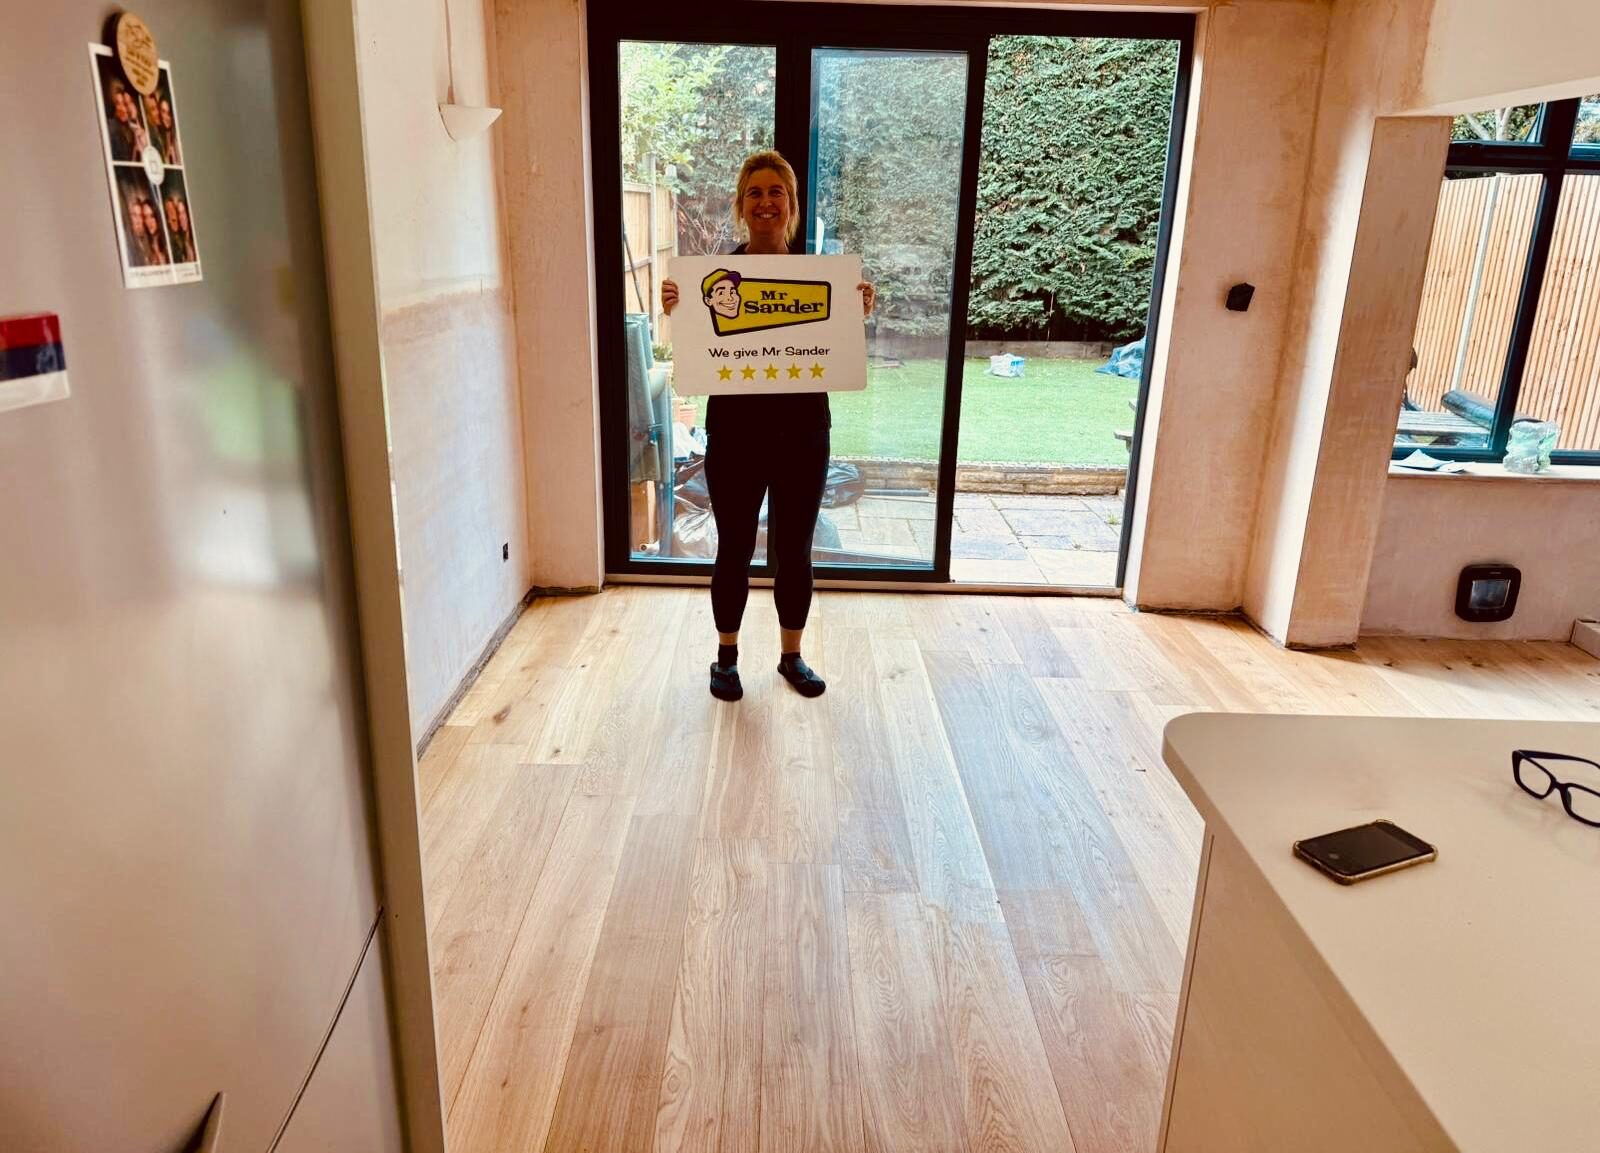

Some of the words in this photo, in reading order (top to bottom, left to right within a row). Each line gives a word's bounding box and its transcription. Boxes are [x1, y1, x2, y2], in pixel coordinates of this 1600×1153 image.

[760, 290, 788, 301] Mr
[744, 299, 824, 314] Sander
[708, 348, 730, 358] We
[733, 347, 758, 359] give
[762, 346, 781, 357] Mr
[785, 345, 830, 356] Sander
